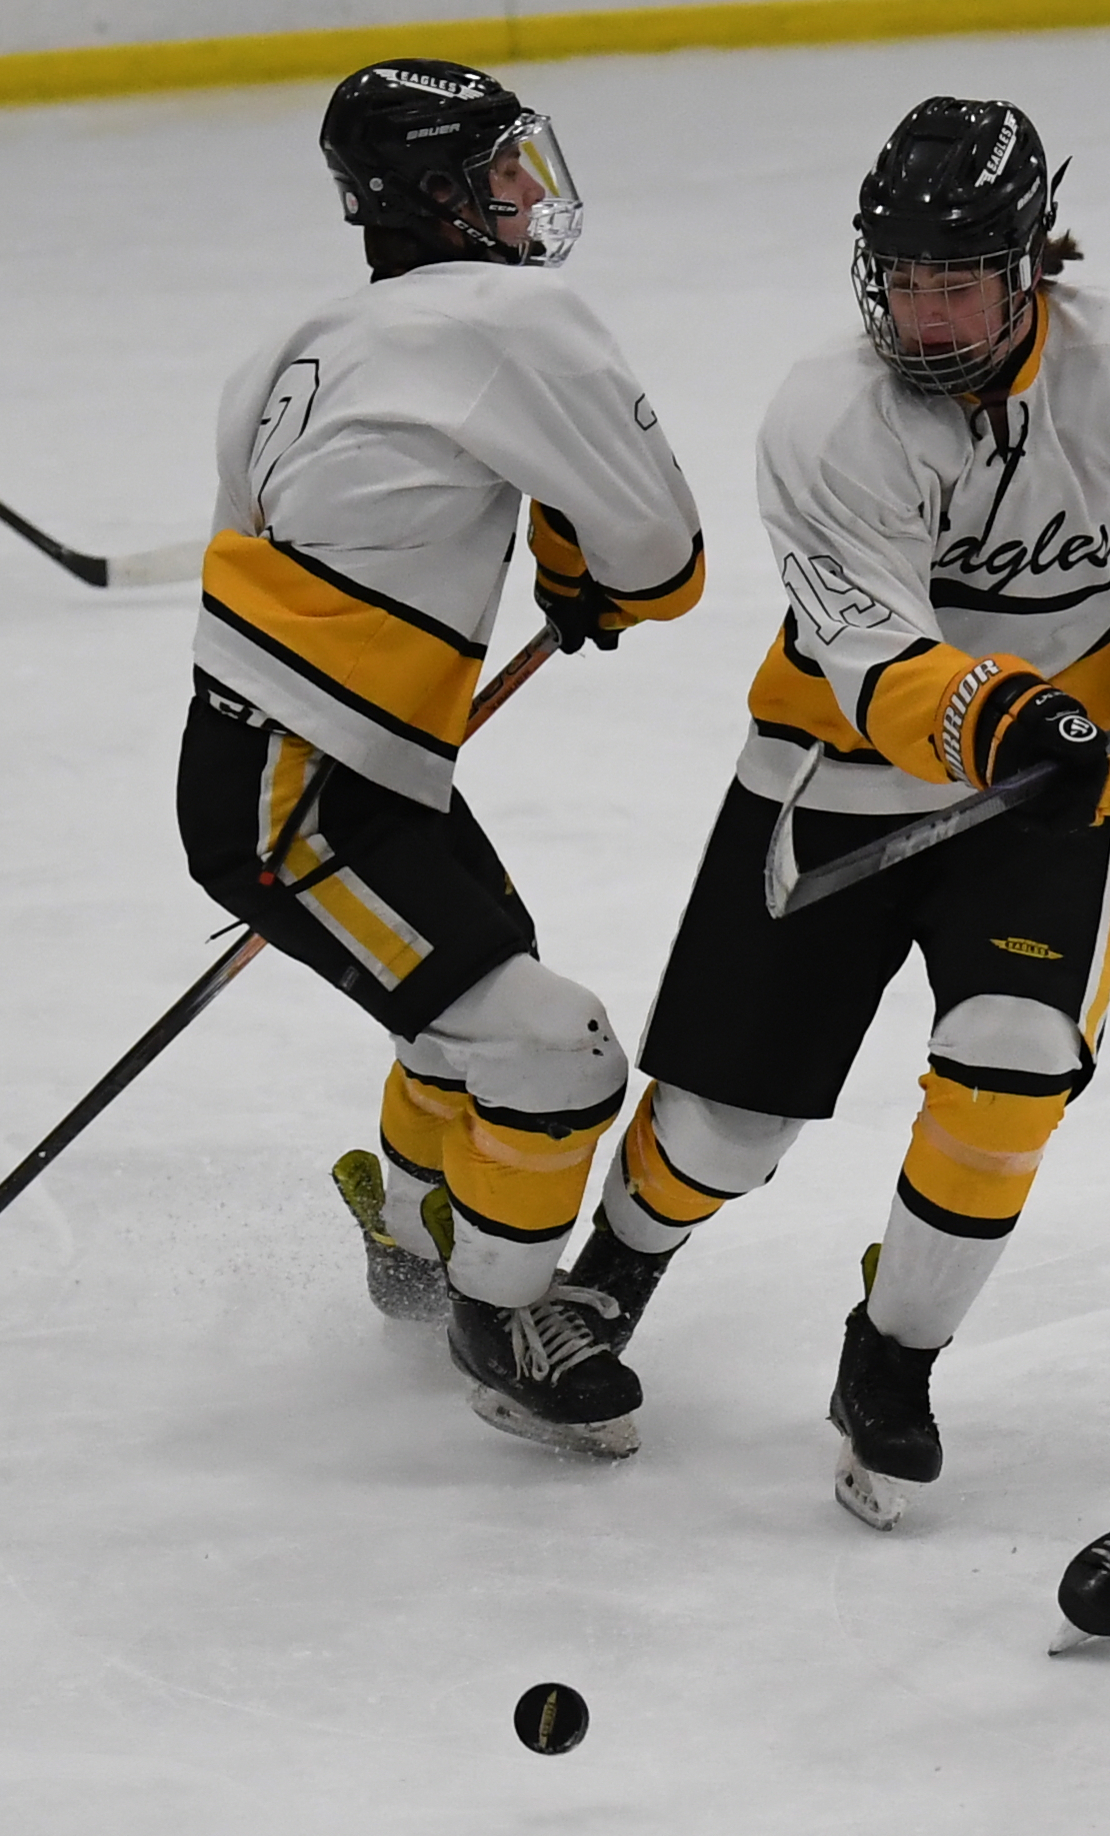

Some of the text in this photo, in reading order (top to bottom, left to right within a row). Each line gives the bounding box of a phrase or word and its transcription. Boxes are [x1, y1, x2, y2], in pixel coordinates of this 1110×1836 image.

[400, 70, 457, 94] EAGLES
[406, 122, 461, 141] BAUER
[986, 127, 1013, 173] EAGLES
[453, 218, 496, 248] CCM
